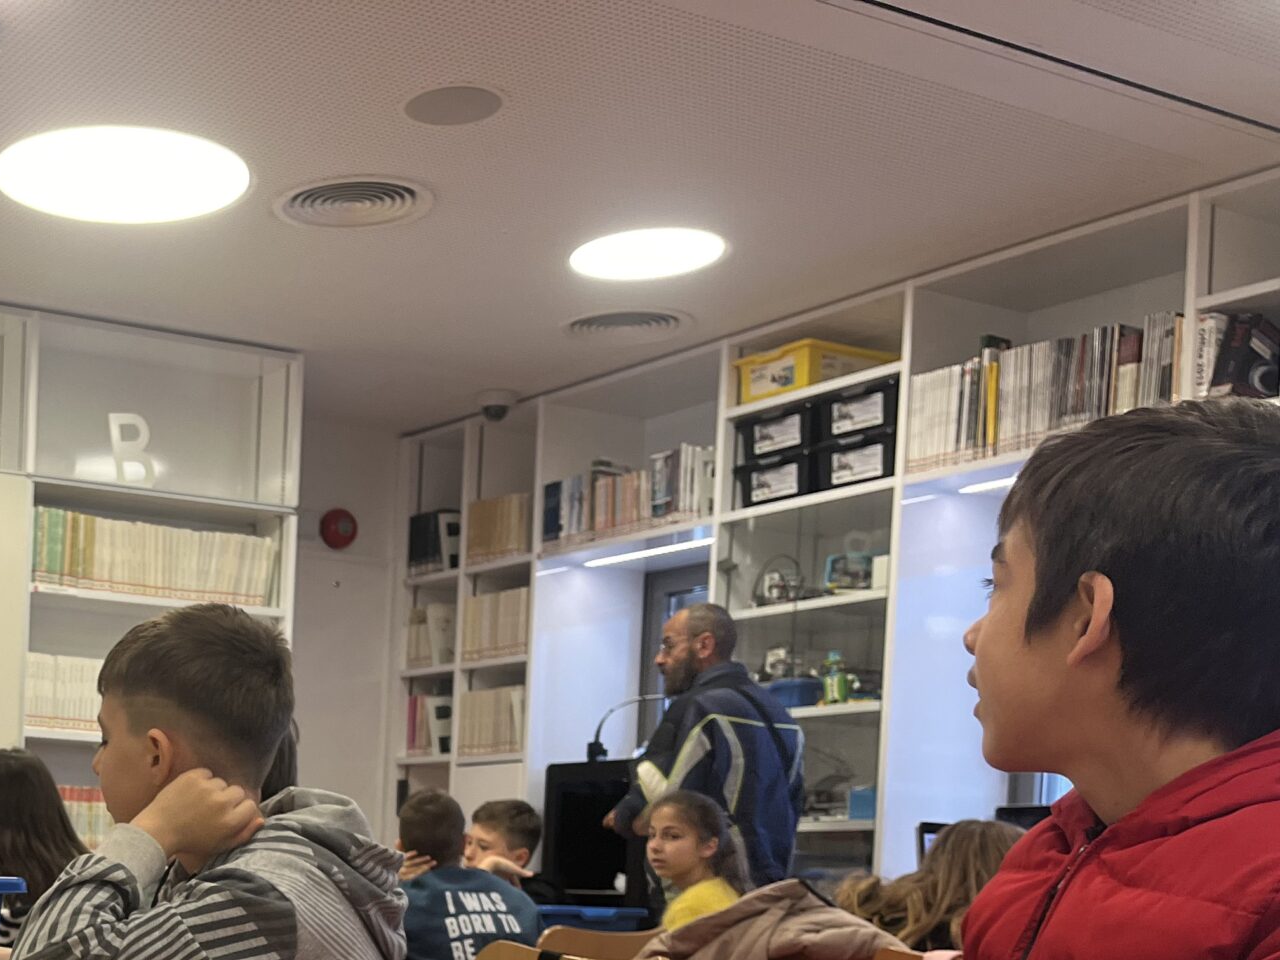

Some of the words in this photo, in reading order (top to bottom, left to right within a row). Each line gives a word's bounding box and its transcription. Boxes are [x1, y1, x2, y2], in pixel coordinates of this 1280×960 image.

[108, 413, 156, 489] B
[445, 891, 456, 914] I
[458, 891, 507, 912] WAS
[445, 913, 497, 939] BORN
[497, 913, 521, 934] TO
